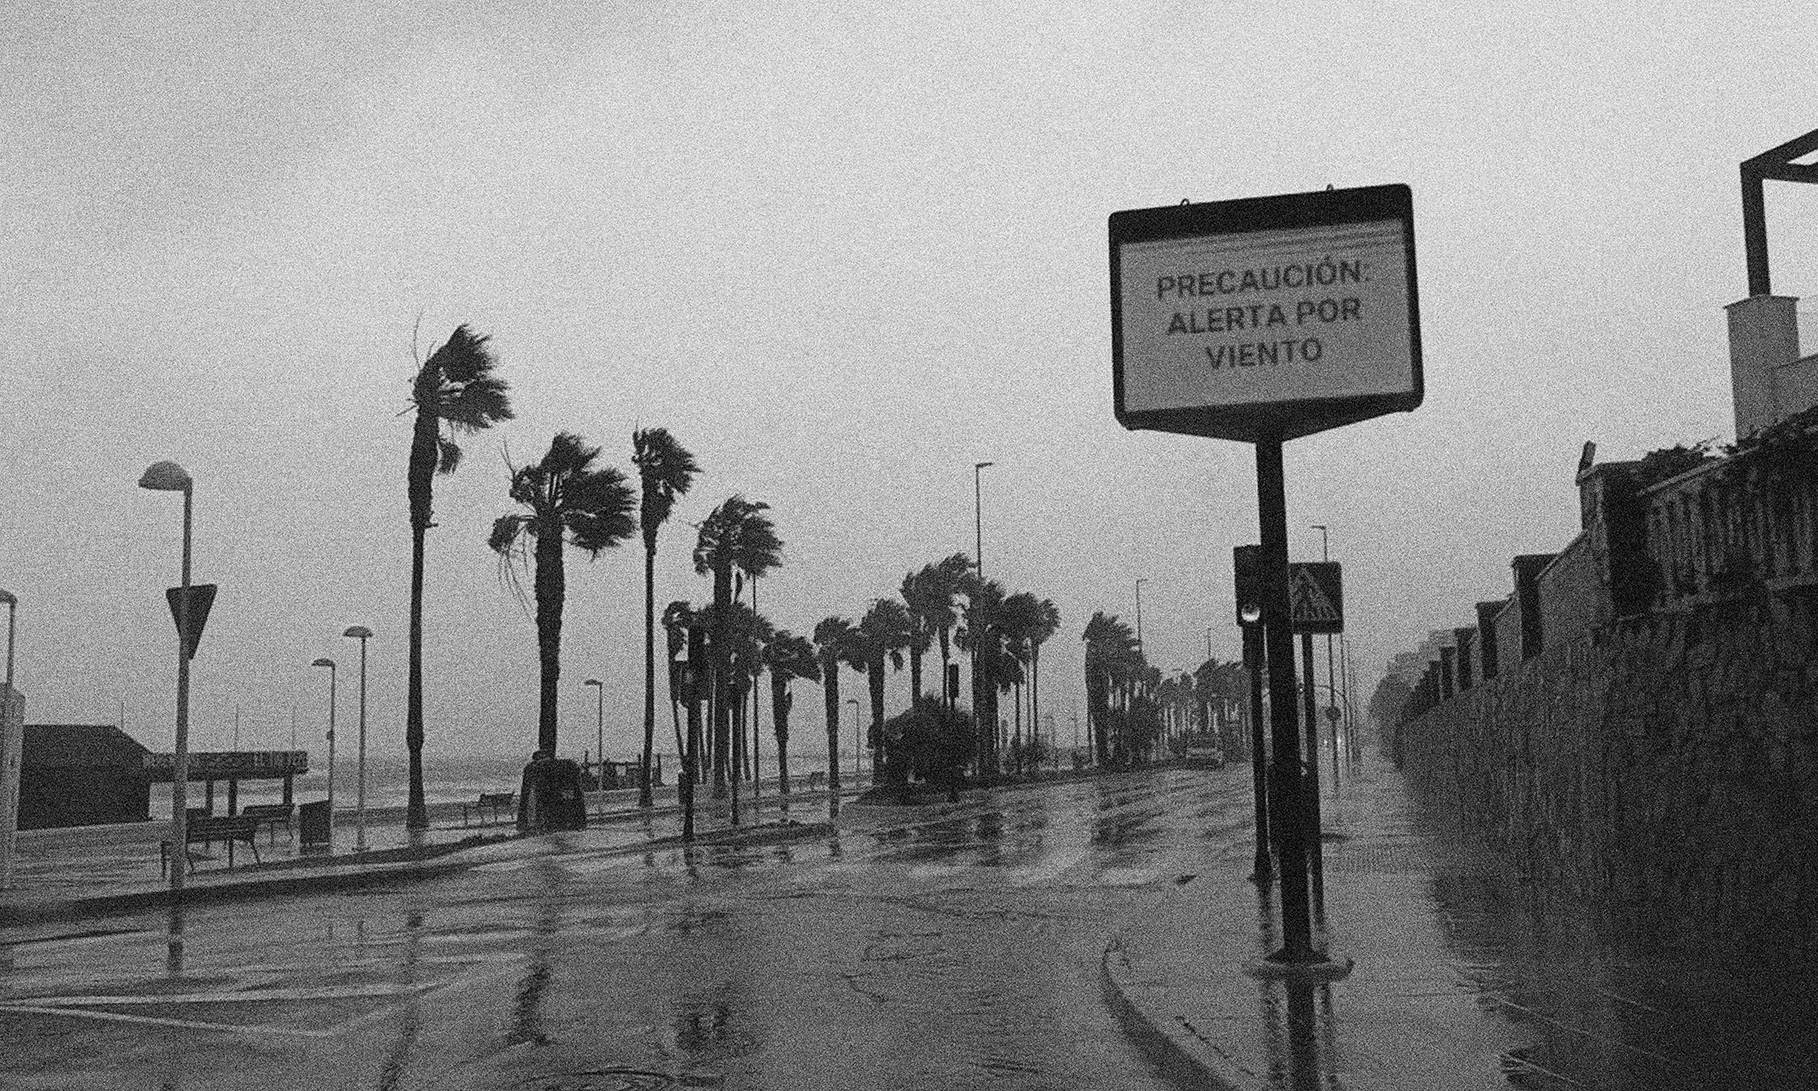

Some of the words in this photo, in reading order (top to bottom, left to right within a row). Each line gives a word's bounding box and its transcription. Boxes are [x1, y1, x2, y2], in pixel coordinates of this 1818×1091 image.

[1156, 255, 1371, 299] PRECAUCIÓN:
[1167, 304, 1287, 335] ALERTA
[1296, 297, 1362, 325] POR
[1205, 337, 1323, 370] VIENTO
